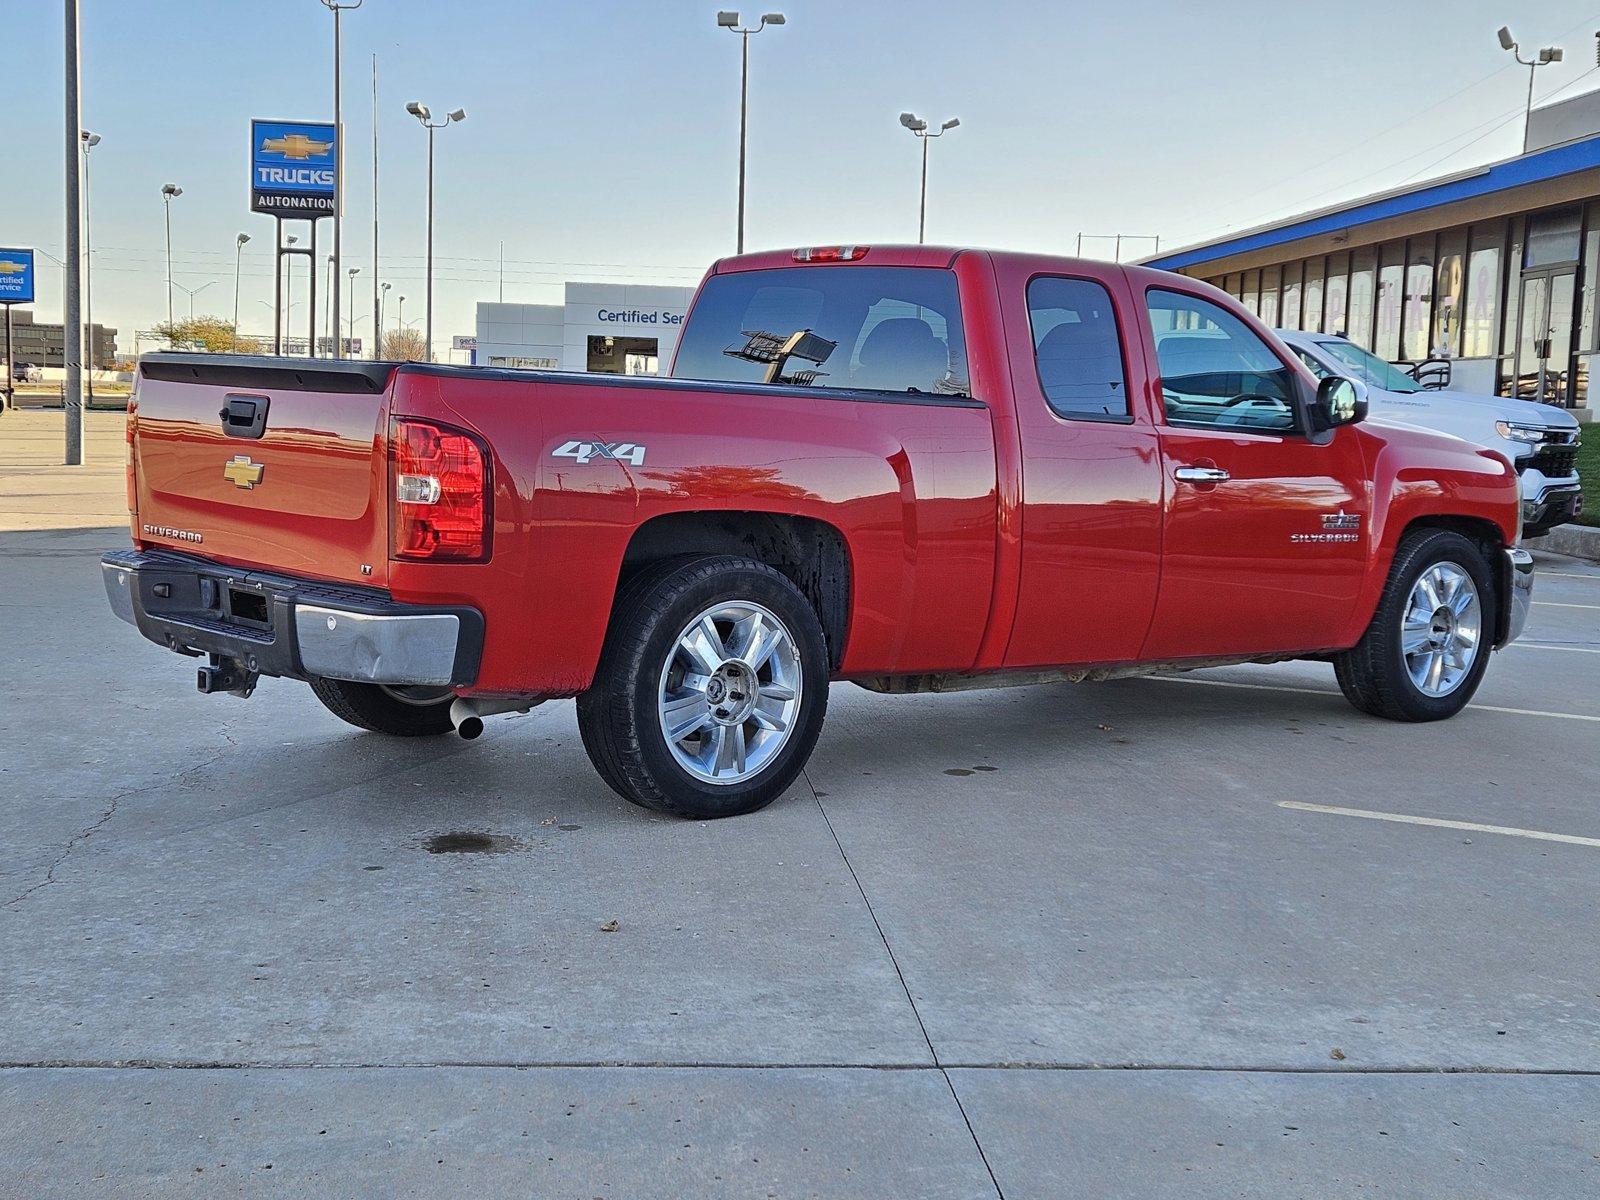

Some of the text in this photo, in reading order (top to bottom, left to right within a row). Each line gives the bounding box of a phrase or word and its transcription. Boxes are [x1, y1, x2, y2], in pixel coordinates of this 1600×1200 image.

[258, 167, 334, 185] TRUCKS
[258, 195, 335, 208] AUTONATION
[597, 309, 658, 324] Certified
[143, 524, 204, 544] SILVERADO
[1290, 533, 1359, 543] SILVERADO
[361, 564, 373, 575] LT
